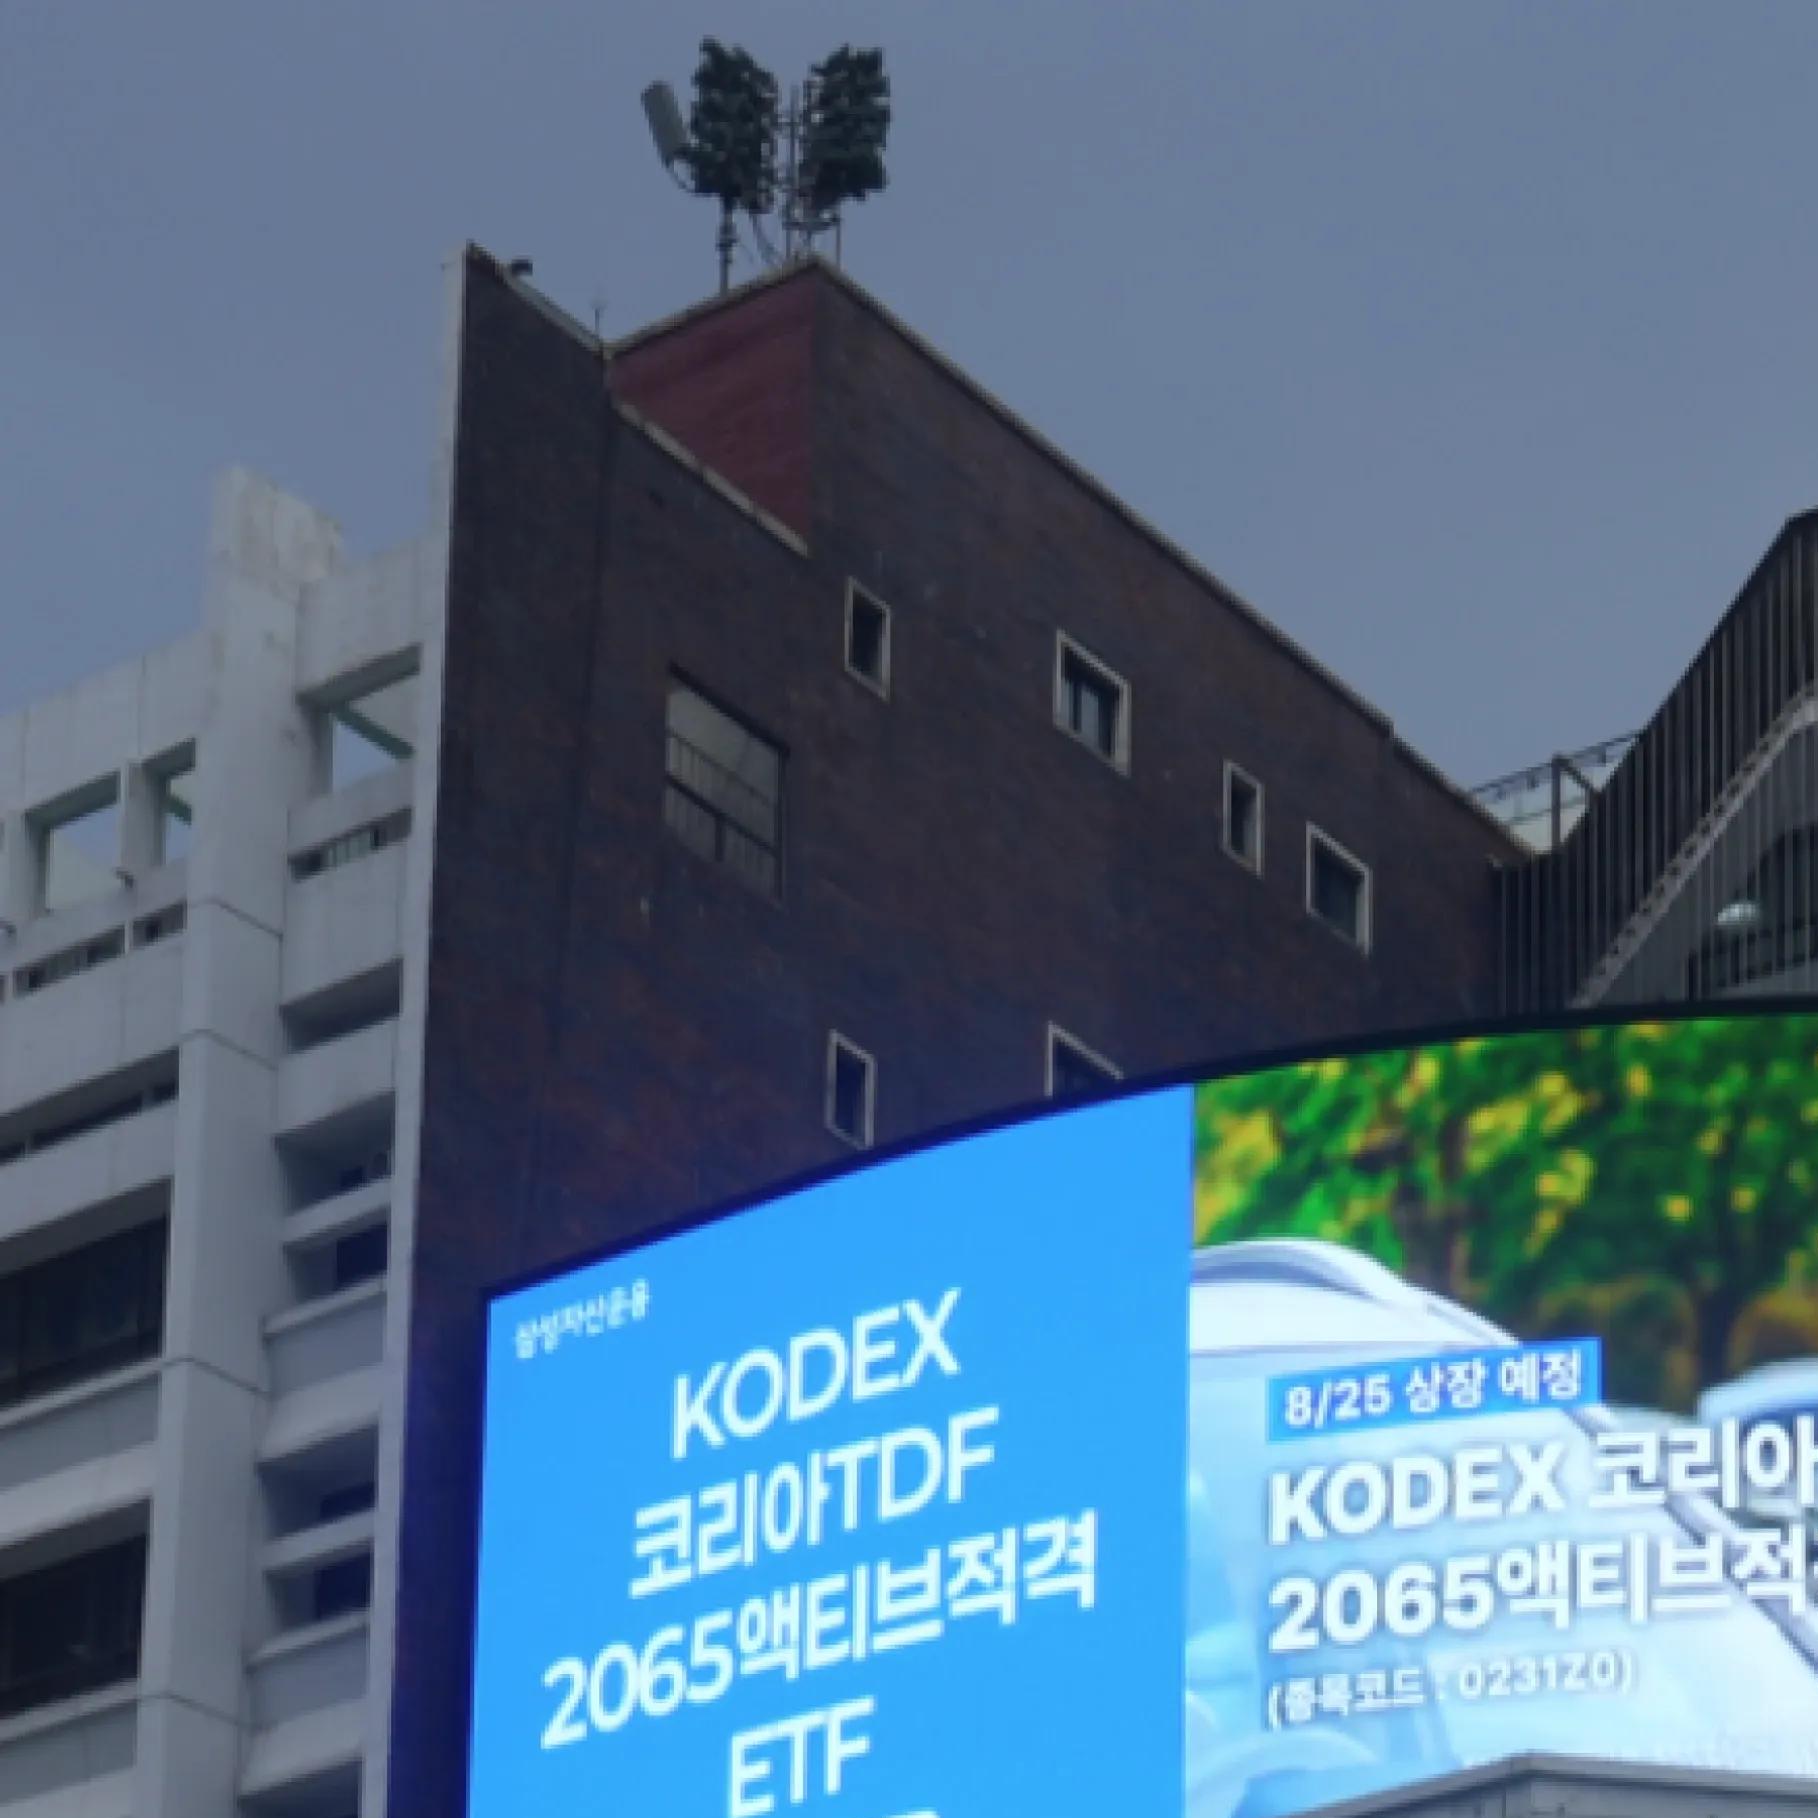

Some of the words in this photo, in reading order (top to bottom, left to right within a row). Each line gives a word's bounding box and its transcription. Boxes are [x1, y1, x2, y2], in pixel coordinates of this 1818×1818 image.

[671, 1286, 961, 1459] KODEX
[1284, 1375, 1393, 1426] 8/25
[1405, 1363, 1483, 1413] 상장
[1499, 1351, 1583, 1402] 예정
[629, 1406, 999, 1598] 코리아TDF
[1267, 1440, 1567, 1545] KODEX
[540, 1509, 1099, 1750] 2065액티브적격
